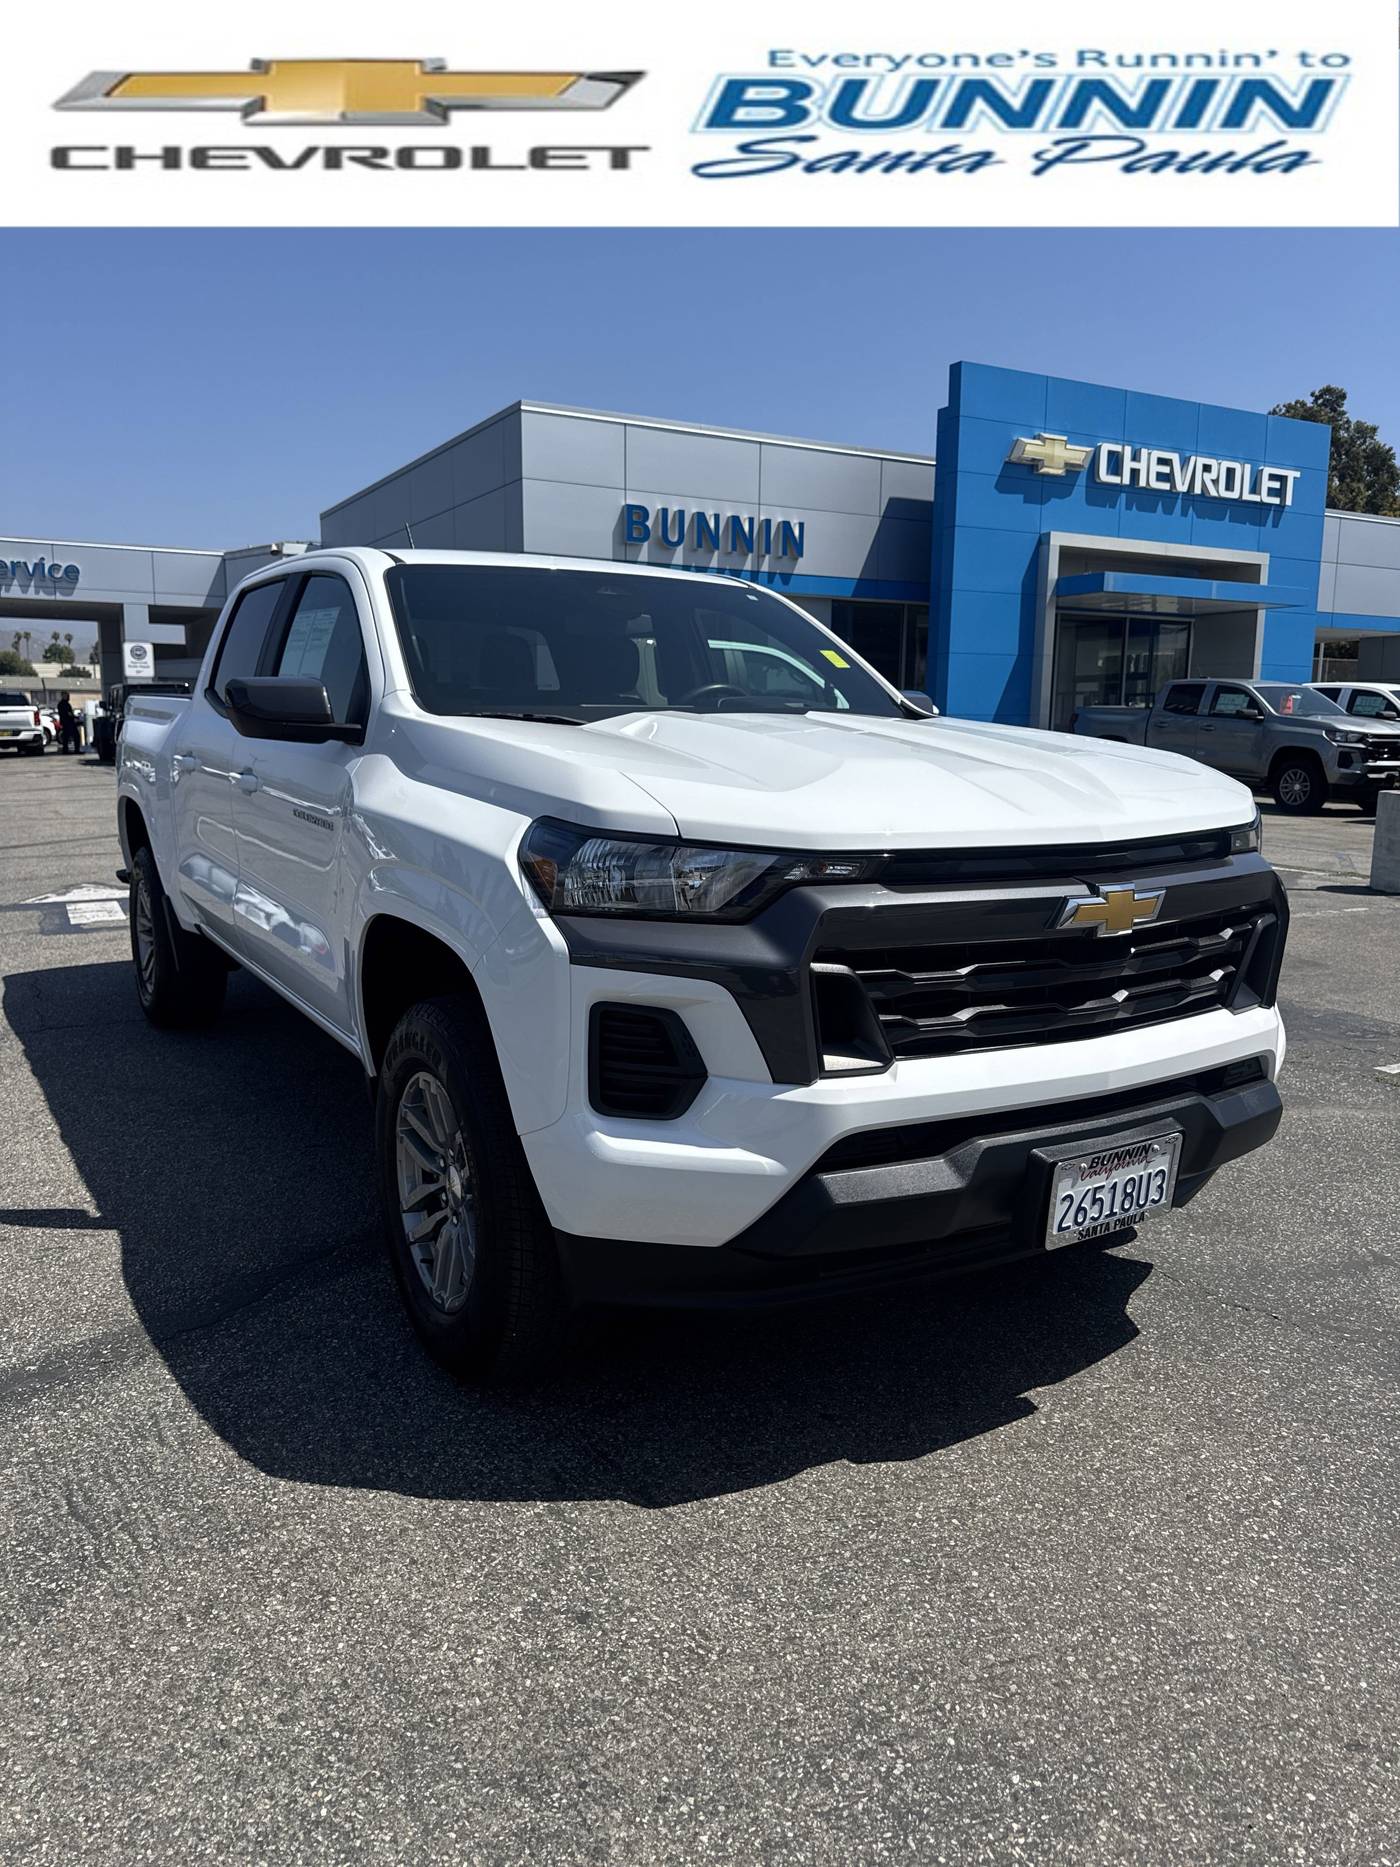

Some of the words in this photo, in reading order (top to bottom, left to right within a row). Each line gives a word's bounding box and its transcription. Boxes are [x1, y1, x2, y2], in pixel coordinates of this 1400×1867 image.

[1096, 442, 1301, 506] CHEVROLET
[625, 503, 805, 558] BUNNIN
[1080, 1154, 1155, 1181] California
[1088, 1143, 1153, 1169] BUNNIN
[1057, 1167, 1167, 1233] 26518U3
[1077, 1222, 1111, 1241] SANTA
[1113, 1211, 1146, 1230] PAULA
